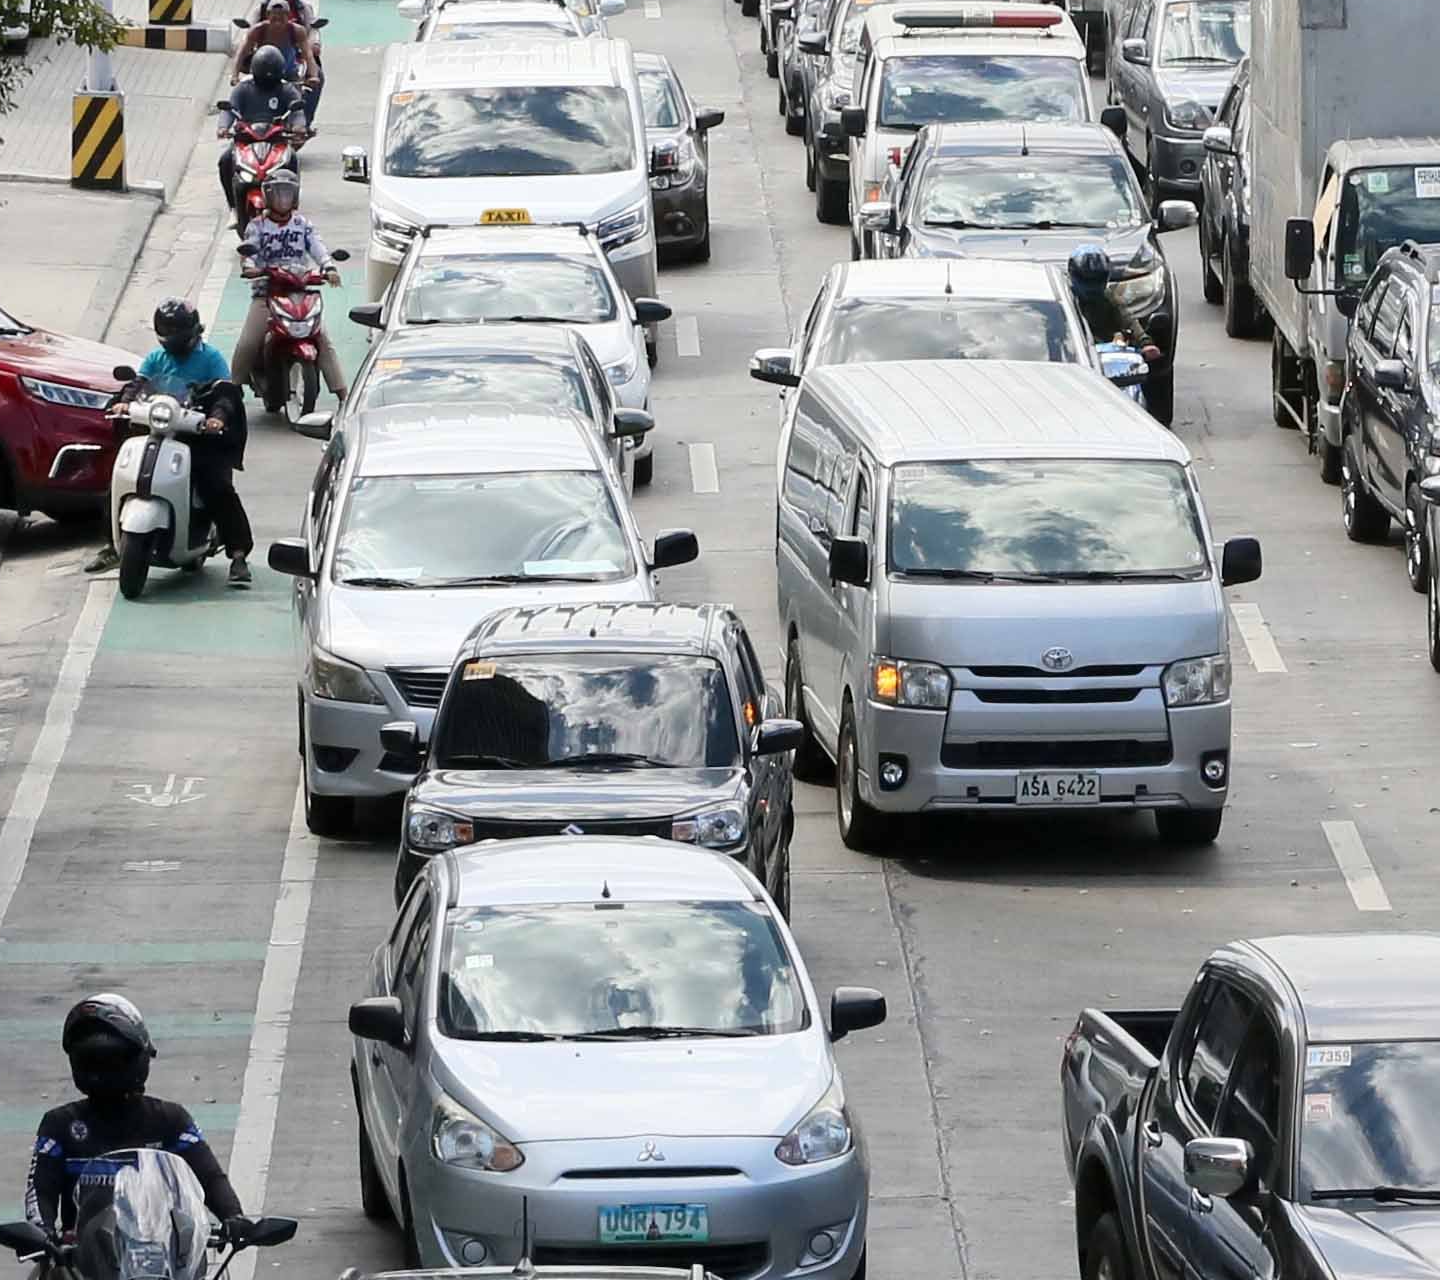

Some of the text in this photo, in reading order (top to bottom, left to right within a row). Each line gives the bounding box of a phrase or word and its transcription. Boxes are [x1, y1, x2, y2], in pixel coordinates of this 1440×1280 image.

[1021, 779, 1096, 797] ASA 6422
[661, 1208, 701, 1231] 794
